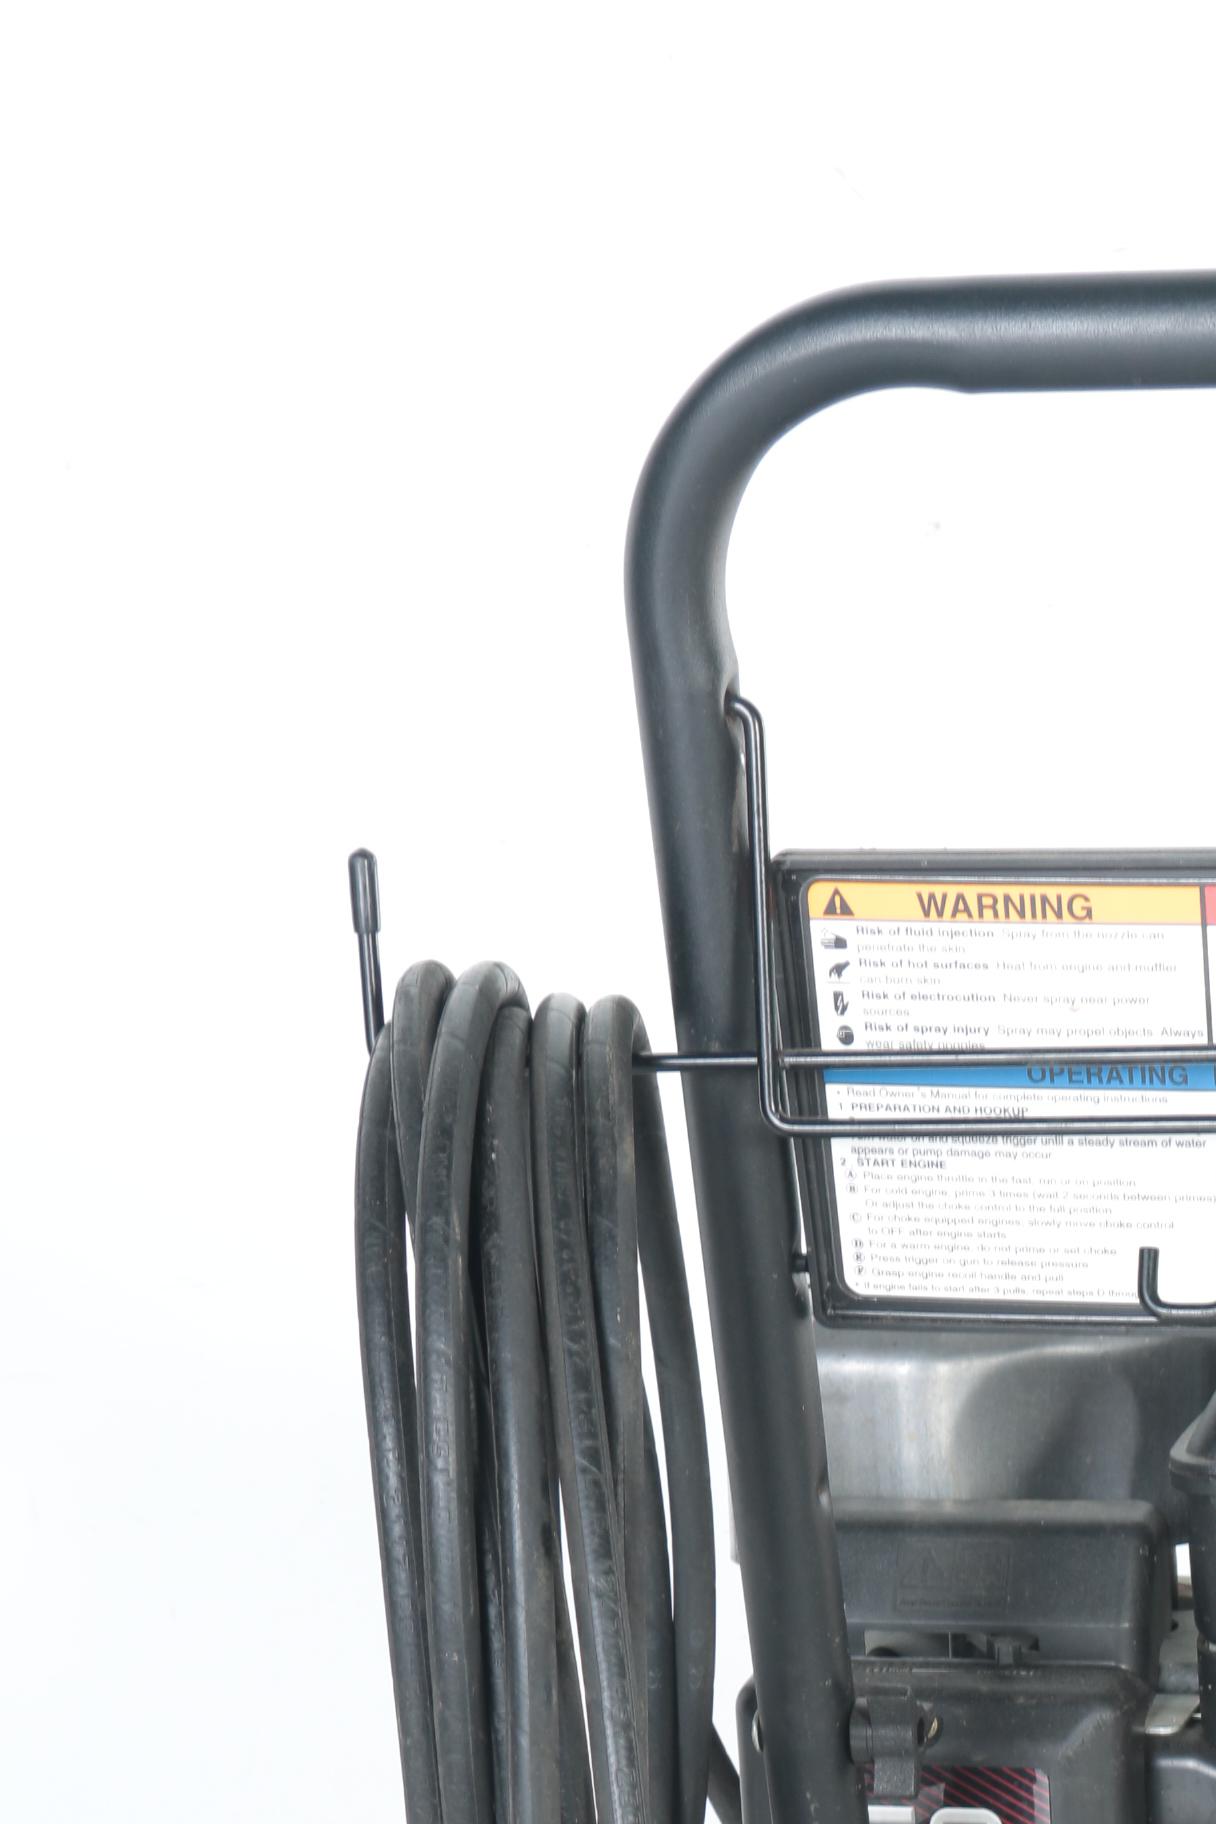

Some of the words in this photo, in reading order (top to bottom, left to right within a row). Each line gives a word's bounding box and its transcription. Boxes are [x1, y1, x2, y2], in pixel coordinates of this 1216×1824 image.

[916, 891, 1094, 921] WARNING
[856, 925, 884, 936] Risk
[888, 926, 901, 937] of
[859, 958, 886, 968] Risk
[891, 958, 903, 968] of
[907, 958, 928, 968] hot
[861, 989, 889, 1000] Risk
[894, 990, 906, 1000] of
[864, 1021, 892, 1032] Risk
[897, 1022, 908, 1033] of
[913, 1024, 948, 1035] spray
[1037, 1026, 1062, 1039] may
[1160, 1026, 1204, 1040] Always
[1026, 1063, 1189, 1087] OPERATING
[847, 1087, 876, 1099] Read
[930, 1089, 971, 1101] Manual
[851, 1102, 940, 1114] PREPARATION
[944, 1104, 970, 1114] AND
[1002, 1137, 1037, 1148] trigger
[1067, 1138, 1074, 1148] a
[1078, 1136, 1115, 1149] steady
[1119, 1136, 1157, 1149] stream
[1161, 1137, 1172, 1149] of
[1175, 1137, 1207, 1149] water
[851, 1148, 894, 1157] appears
[912, 1149, 943, 1158] pump
[946, 1148, 990, 1159] damage
[994, 1151, 1018, 1160] may
[857, 1158, 896, 1169] START
[900, 1158, 947, 1170] ENGINE
